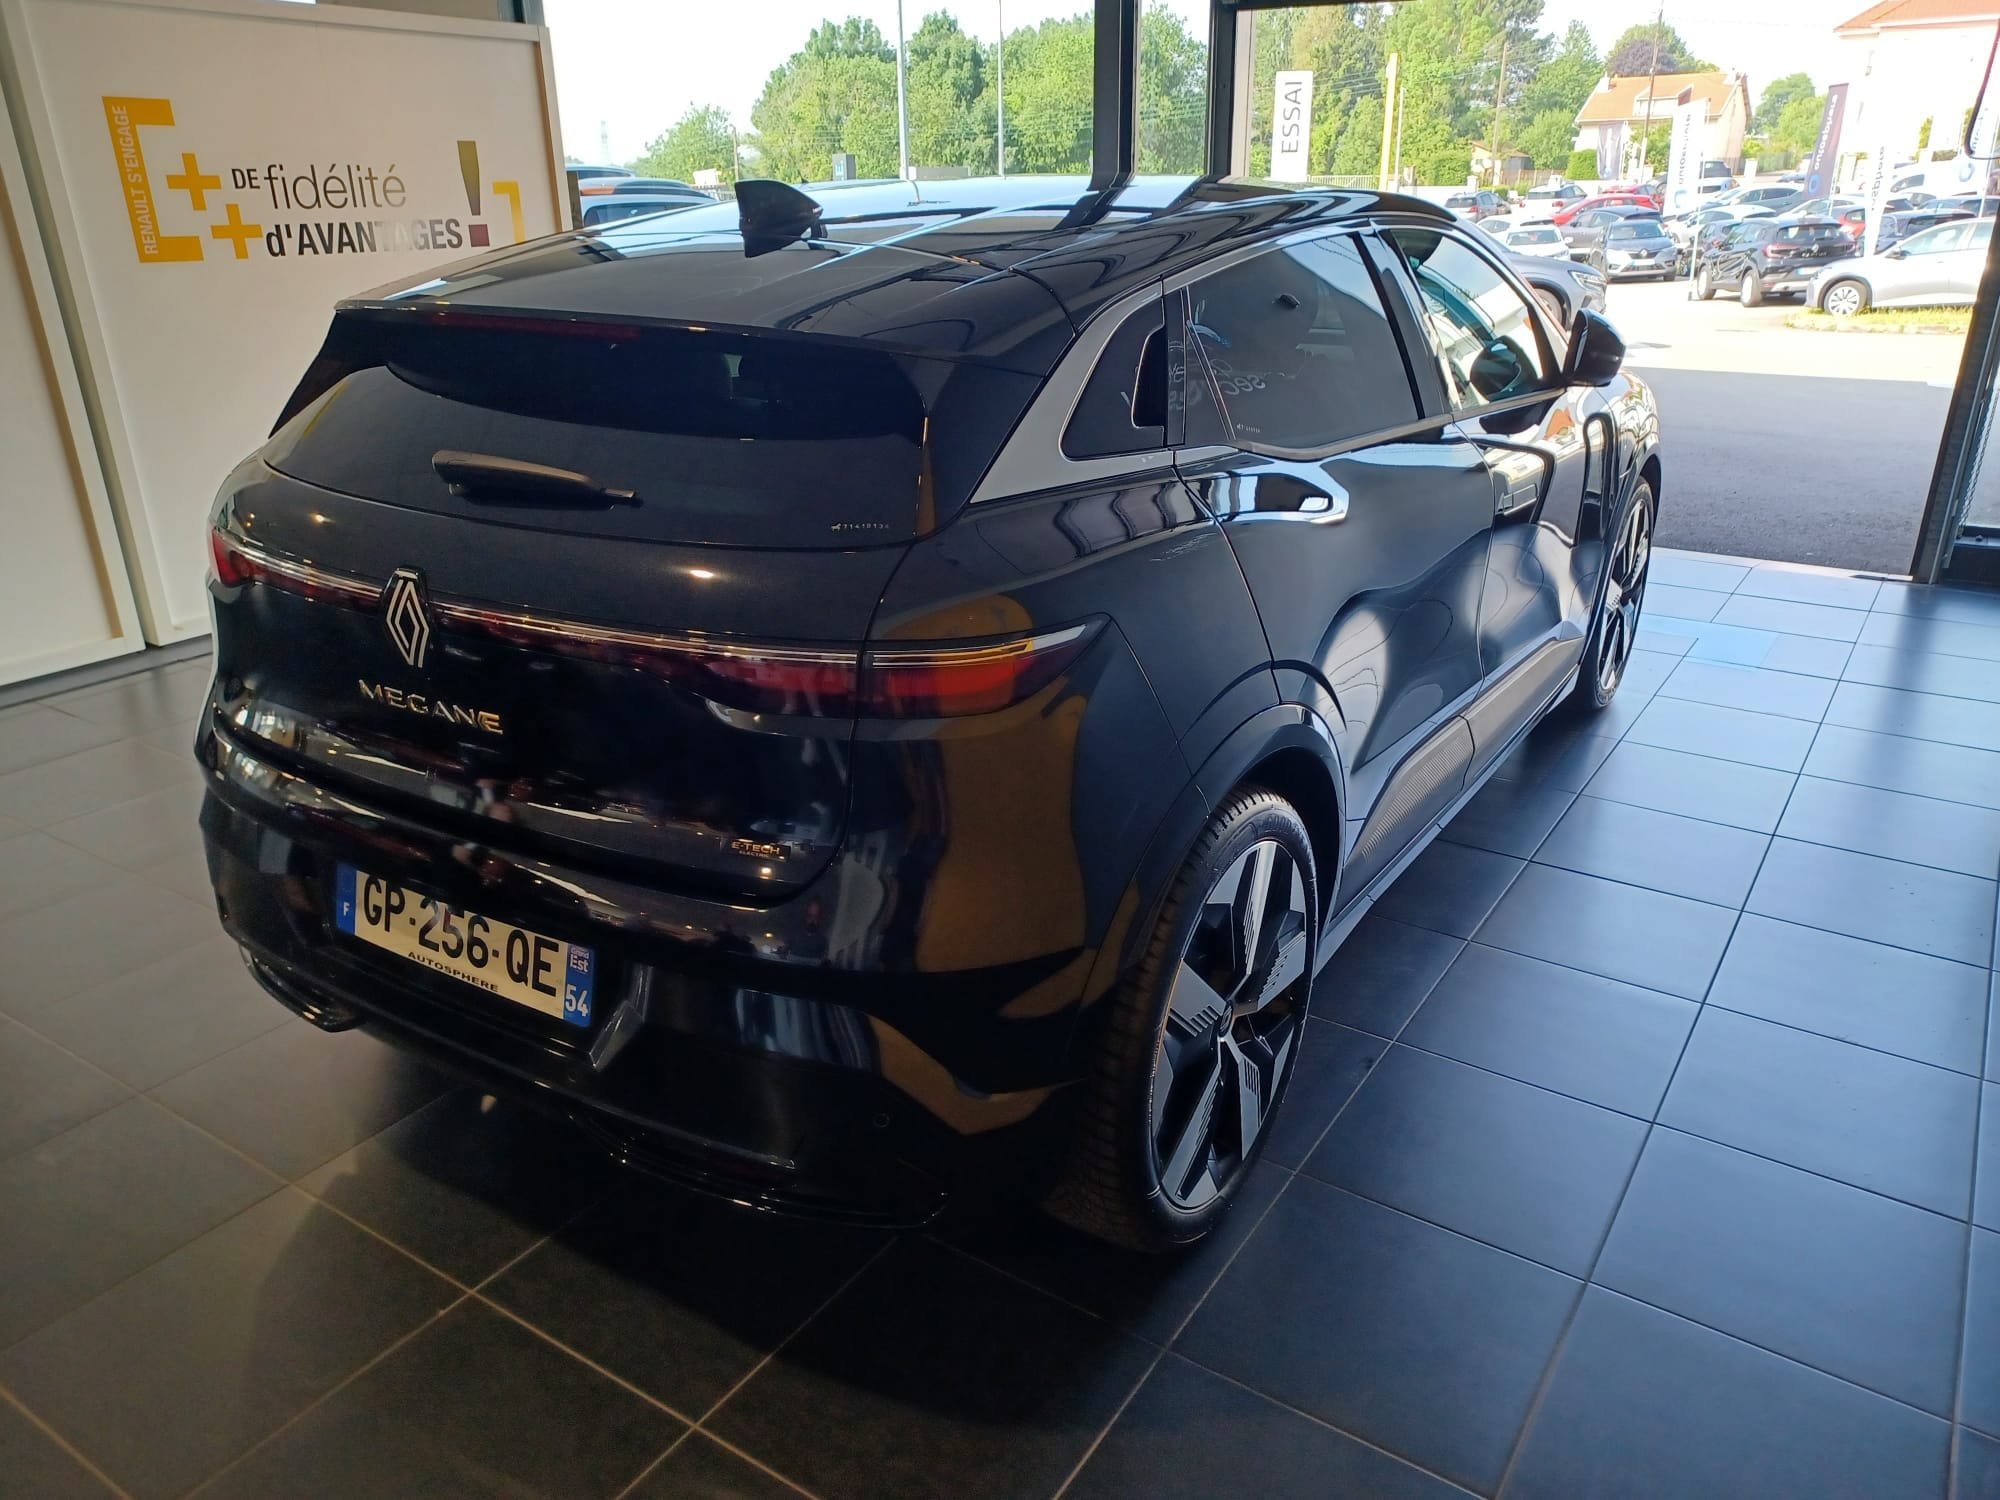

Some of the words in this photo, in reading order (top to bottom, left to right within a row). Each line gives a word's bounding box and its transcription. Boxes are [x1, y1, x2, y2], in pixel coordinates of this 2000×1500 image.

[1281, 82, 1302, 153] ESSAI
[112, 105, 143, 183] S'ENGAGE
[232, 168, 260, 189] DE
[264, 163, 407, 210] fidélité
[130, 188, 159, 254] RENAULT
[266, 218, 463, 257] d'AVANTAGES
[358, 679, 504, 735] MEGANE
[343, 901, 351, 916] F
[407, 951, 499, 993] AUTOSPHERE
[570, 954, 589, 973] Est
[565, 983, 589, 1017] 54
